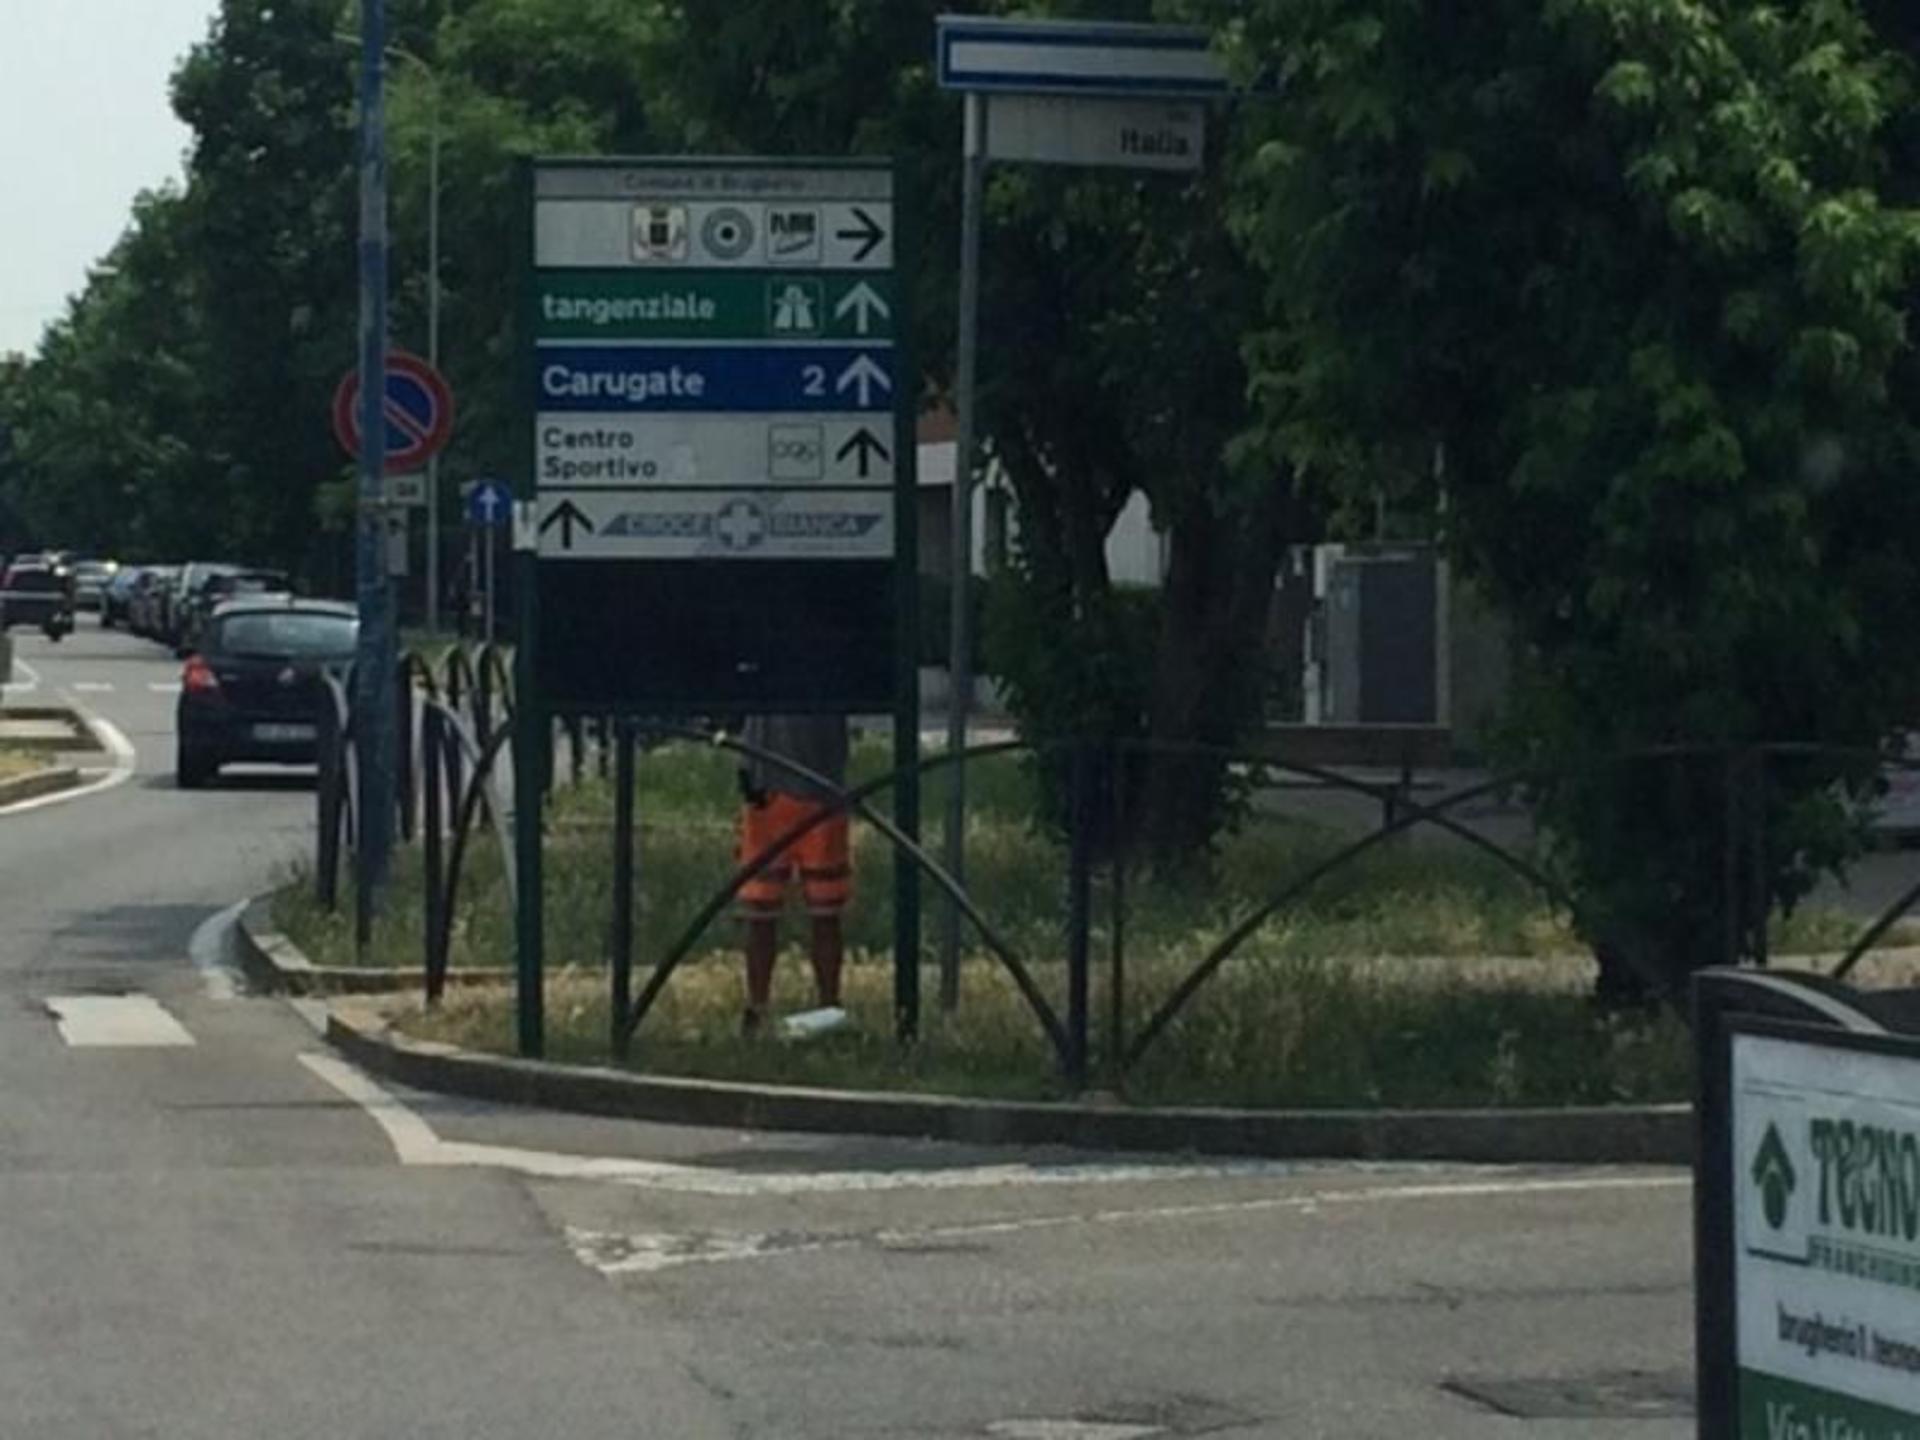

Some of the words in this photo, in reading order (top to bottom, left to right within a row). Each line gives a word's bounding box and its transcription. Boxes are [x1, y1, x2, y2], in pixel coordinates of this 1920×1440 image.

[1120, 128, 1188, 155] Italia
[543, 293, 715, 324] tangenziale
[543, 366, 705, 401] Carugate
[803, 366, 825, 396] 2
[543, 428, 634, 449] Centro
[543, 456, 657, 480] Sportivo
